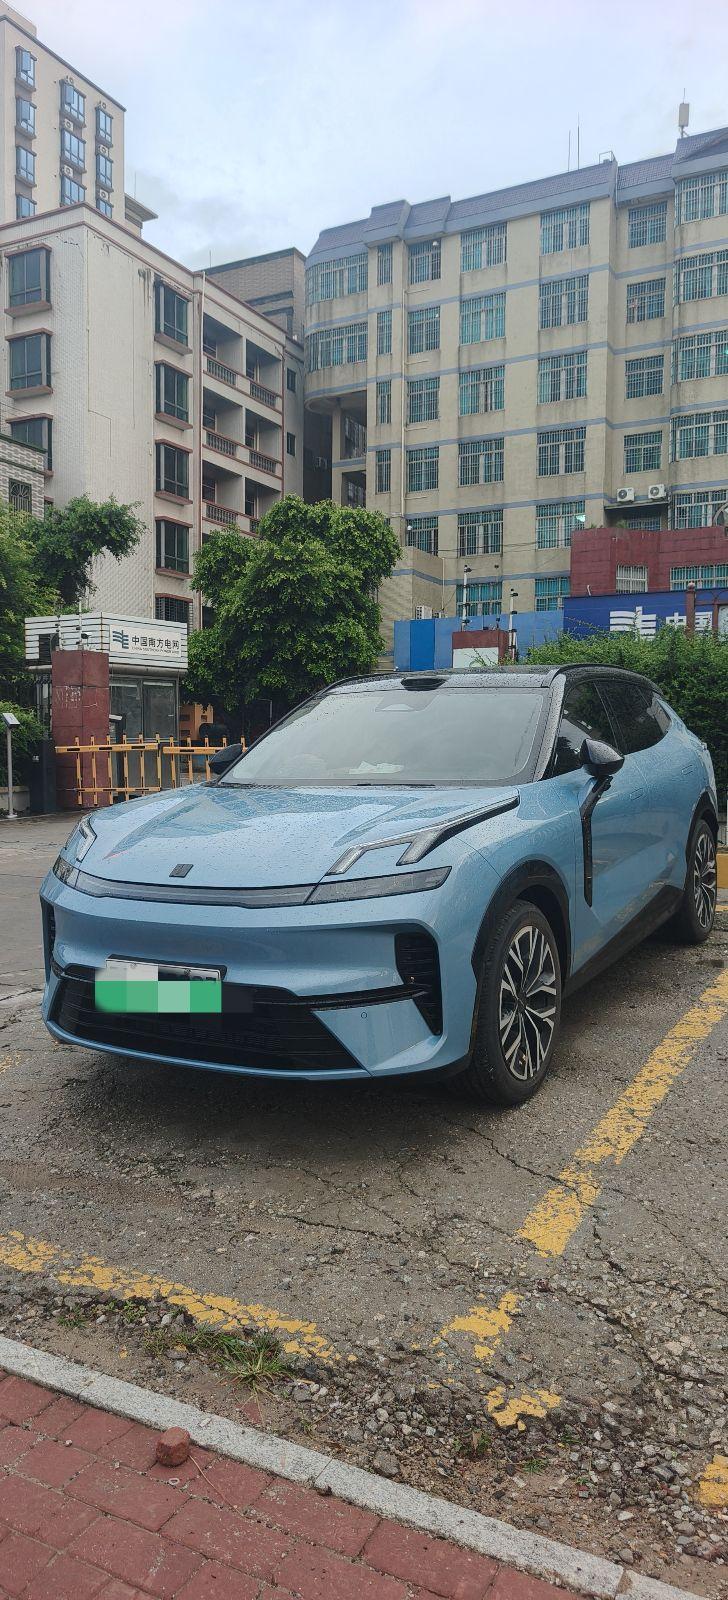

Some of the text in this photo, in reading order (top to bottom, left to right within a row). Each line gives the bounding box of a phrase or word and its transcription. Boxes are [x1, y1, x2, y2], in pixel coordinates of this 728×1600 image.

[131, 635, 180, 650] 中国南方电网
